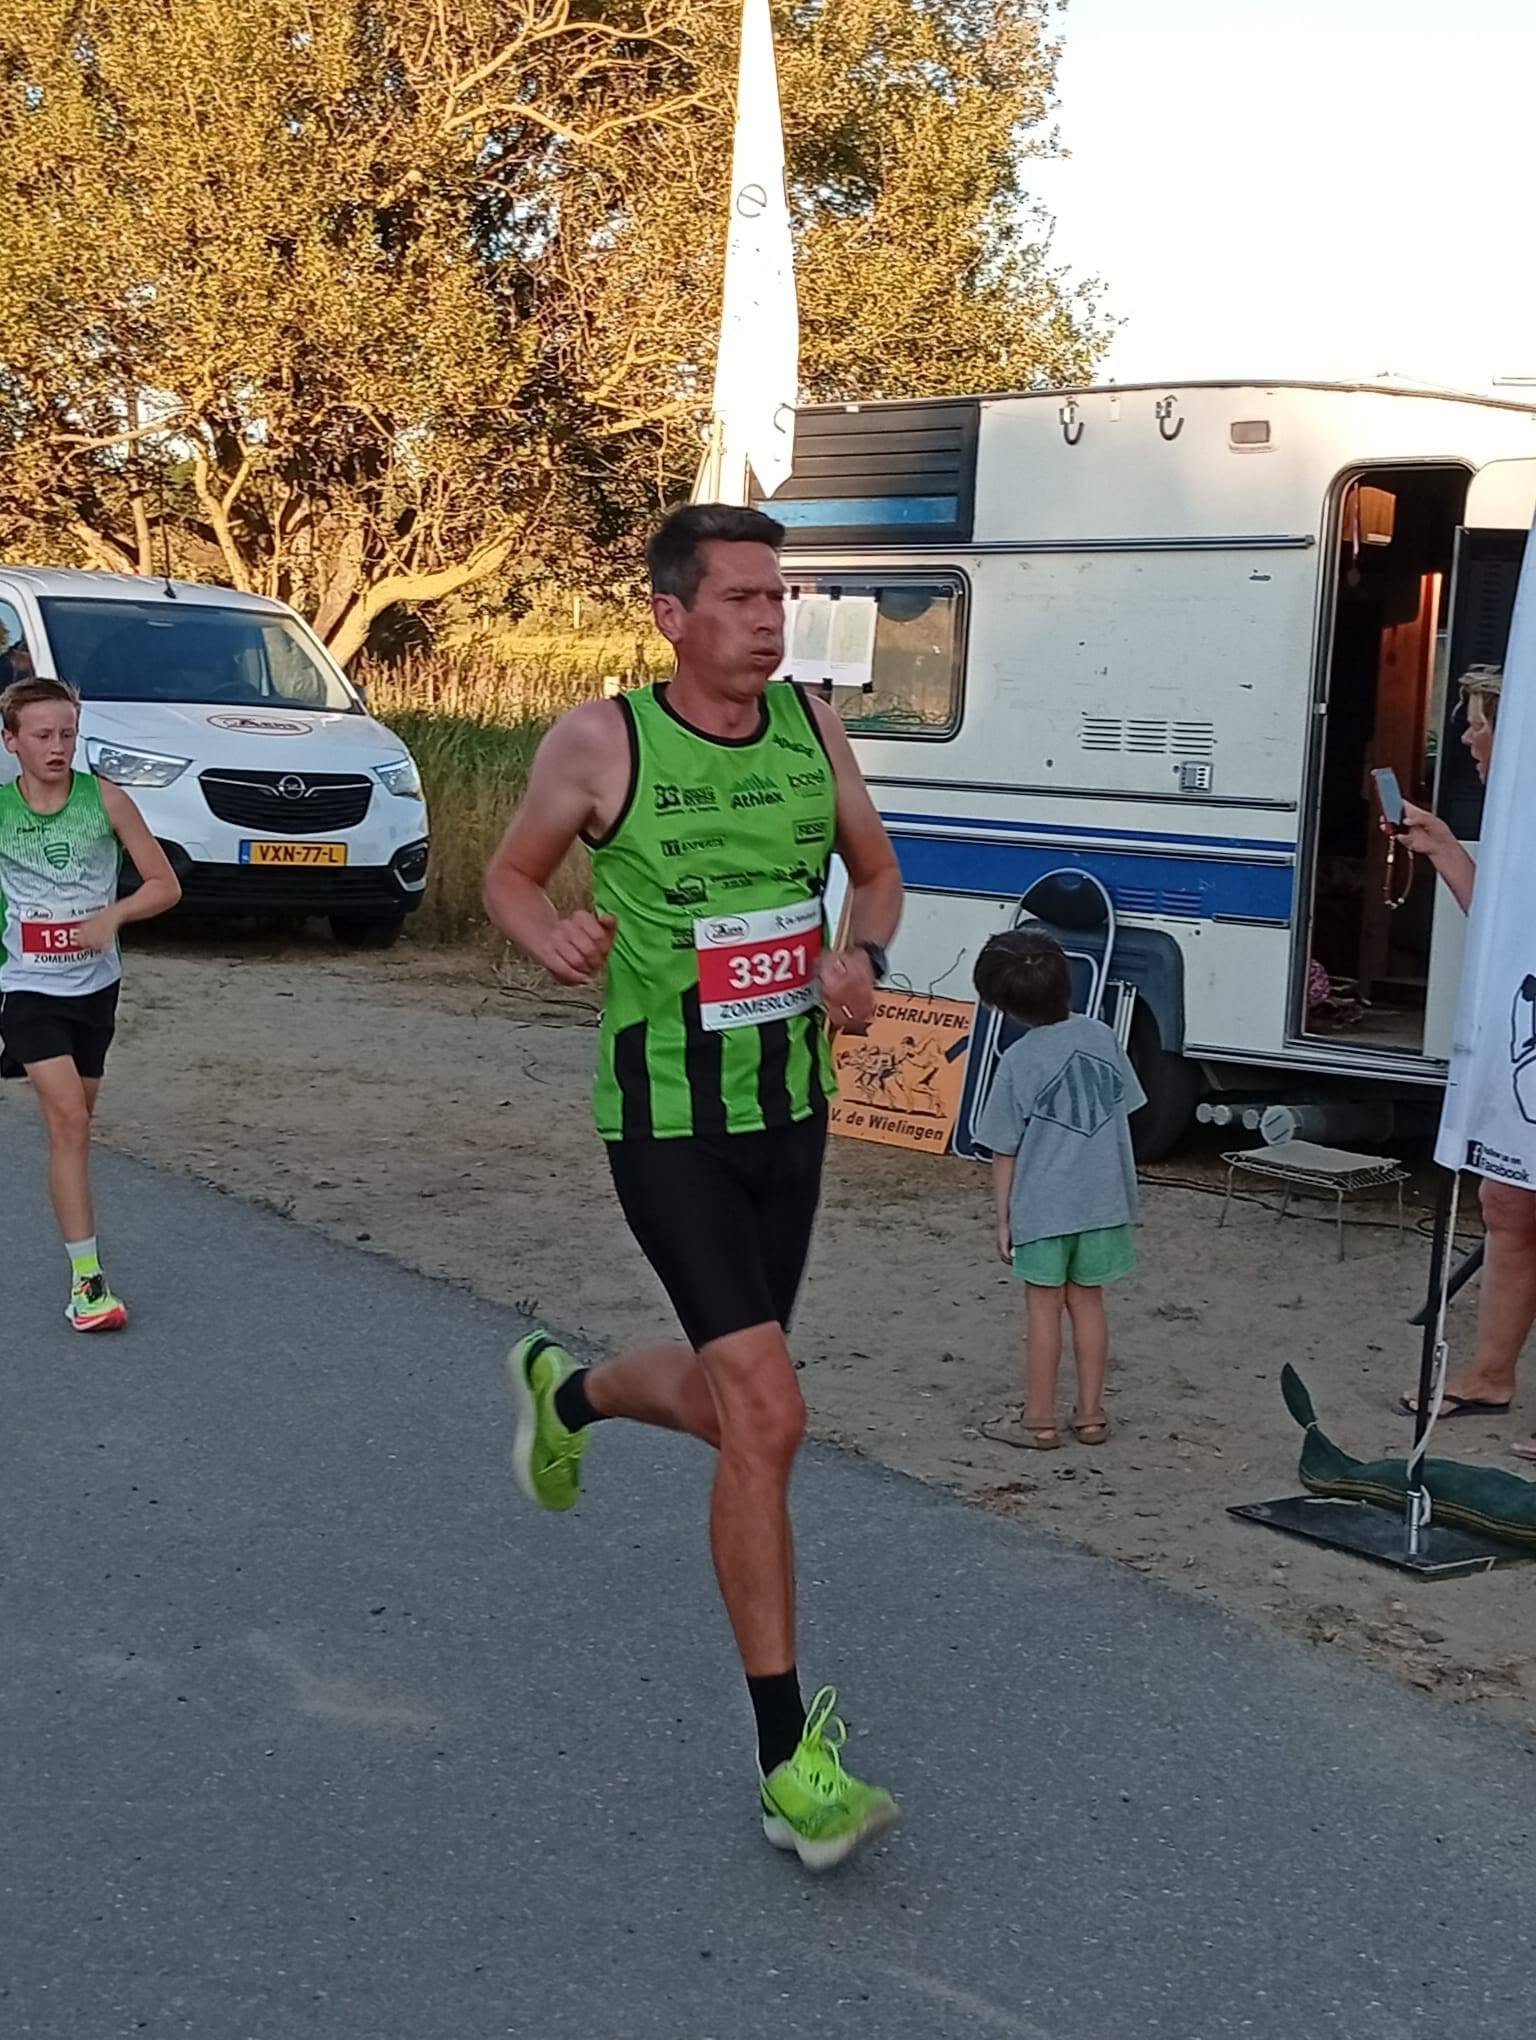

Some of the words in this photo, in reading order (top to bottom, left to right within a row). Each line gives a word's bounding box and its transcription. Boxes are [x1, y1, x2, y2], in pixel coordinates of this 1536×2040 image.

[260, 845, 339, 863] VXN-77-L
[728, 944, 806, 989] 3321
[846, 1111, 863, 1126] de
[869, 1114, 944, 1141] Wielingen
